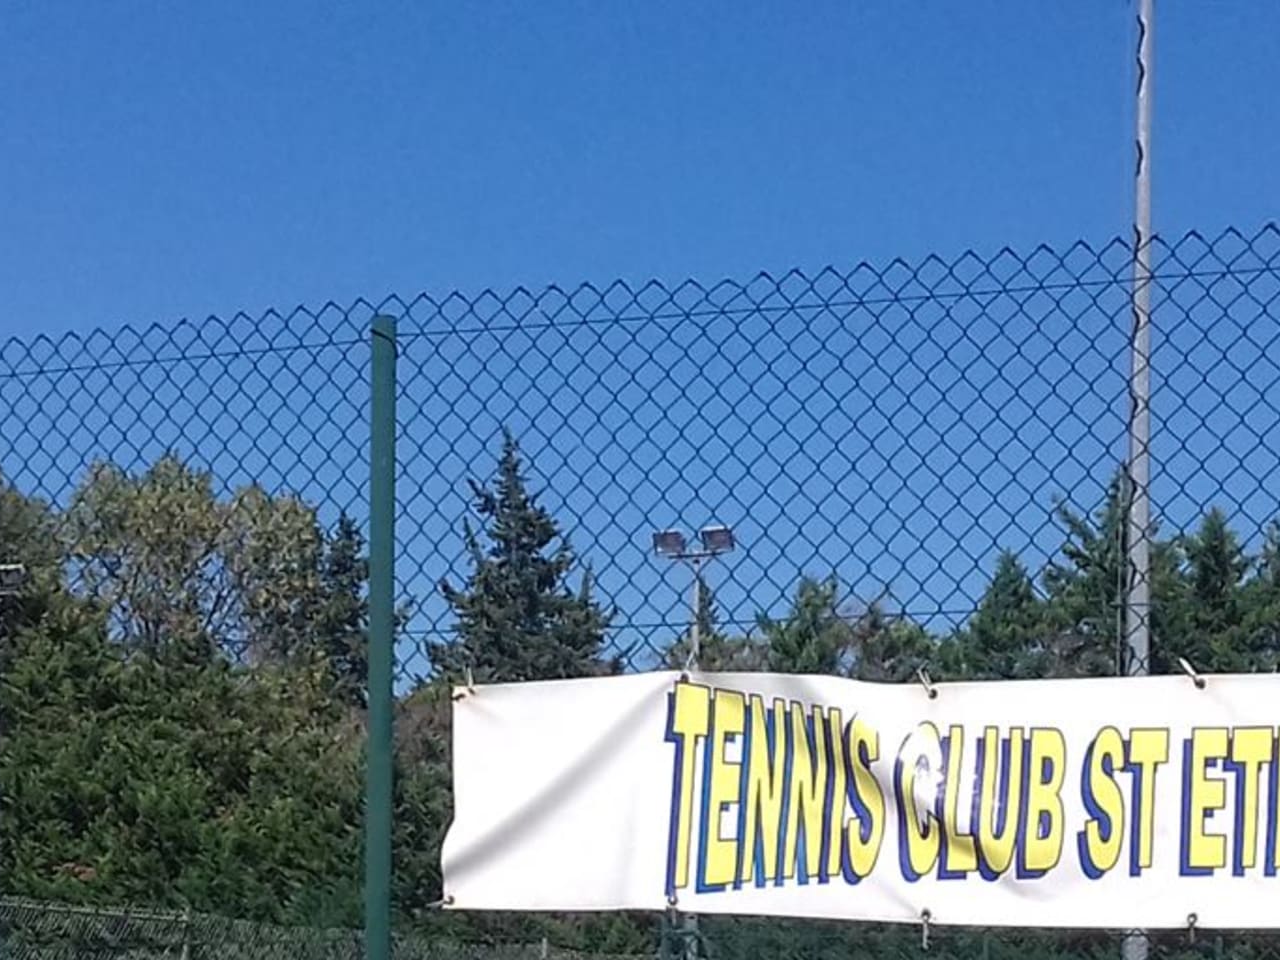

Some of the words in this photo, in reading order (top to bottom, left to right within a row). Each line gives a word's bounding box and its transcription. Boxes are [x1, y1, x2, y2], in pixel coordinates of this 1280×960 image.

[665, 682, 886, 897] TENNIS
[895, 721, 1067, 882] CLUB
[1077, 725, 1170, 880] ST
